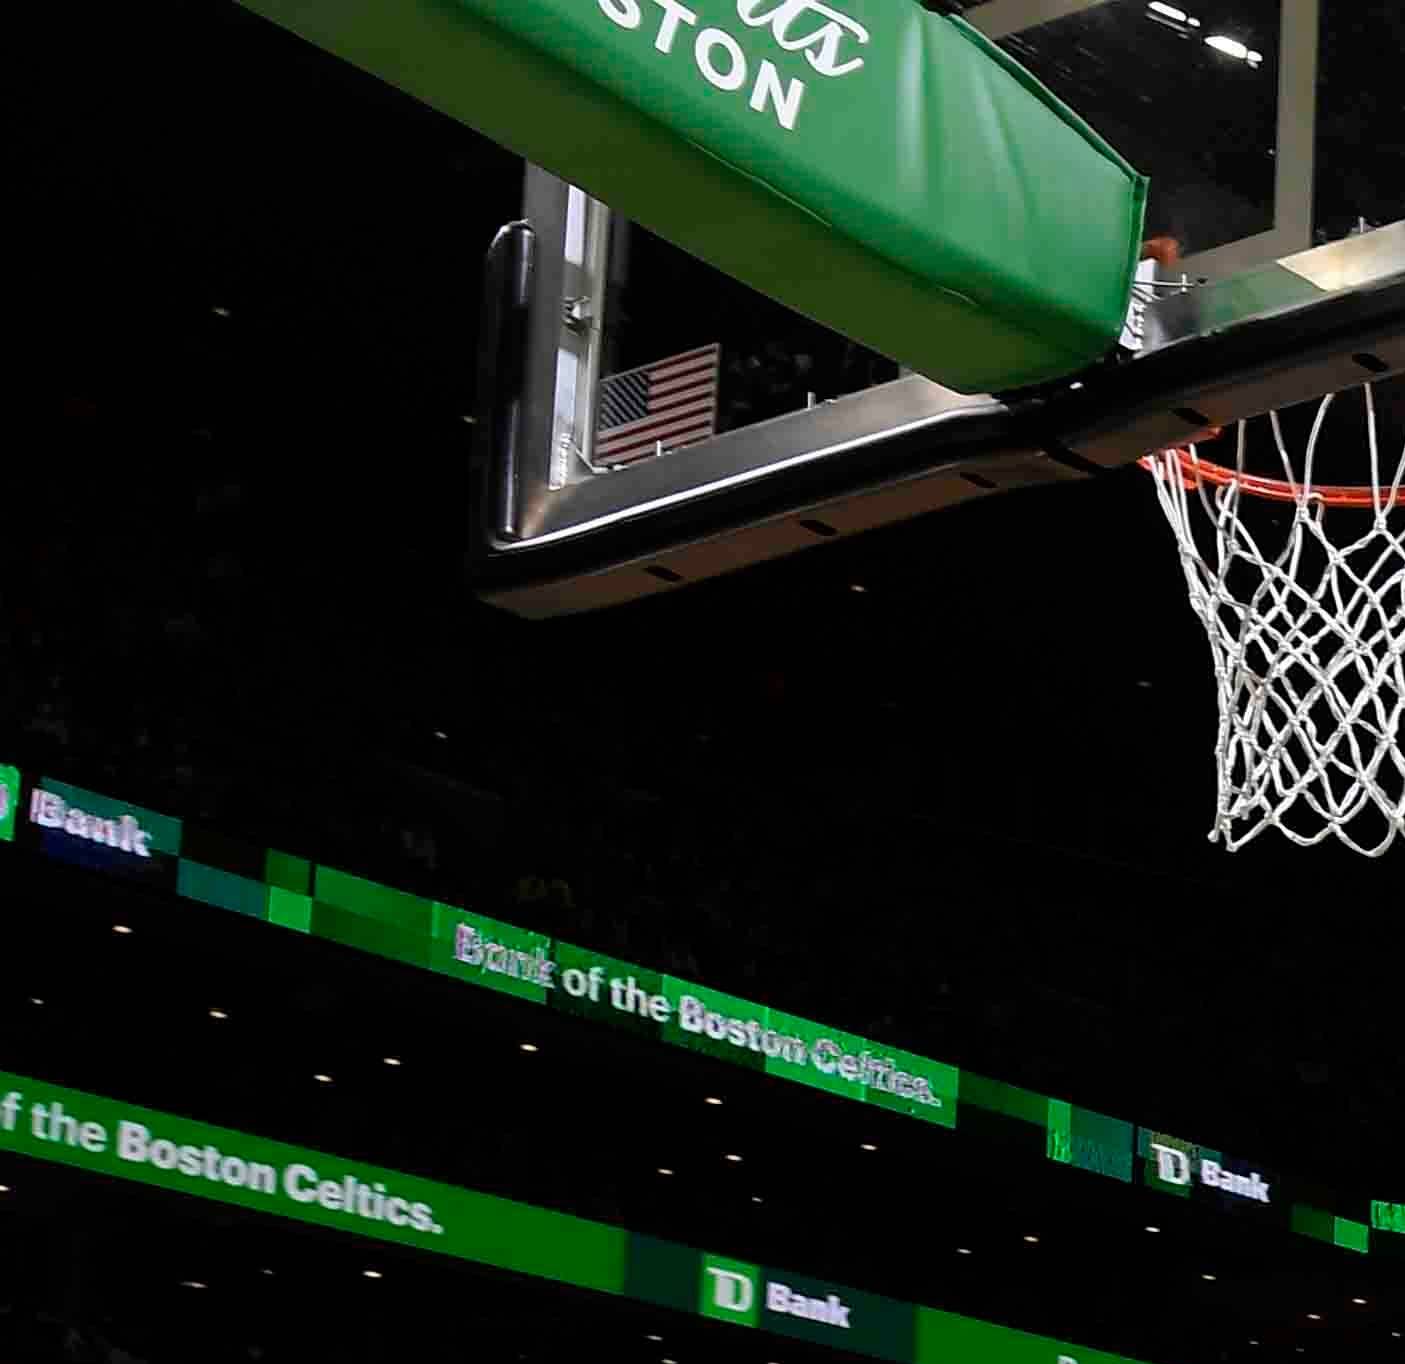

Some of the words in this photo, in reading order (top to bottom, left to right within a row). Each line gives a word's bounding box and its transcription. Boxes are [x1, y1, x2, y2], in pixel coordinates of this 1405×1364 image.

[30, 787, 152, 857] Bank
[455, 923, 556, 988] Bank
[562, 966, 604, 1001] of
[610, 976, 671, 1022] the
[678, 995, 807, 1066] Boston
[0, 1091, 22, 1130] f
[30, 1102, 107, 1152] the
[117, 1120, 276, 1194] Boston
[283, 1163, 444, 1234] Celtics.
[1201, 1159, 1270, 1203] Bank
[704, 1266, 753, 1313] TD
[766, 1281, 850, 1328] Bank
